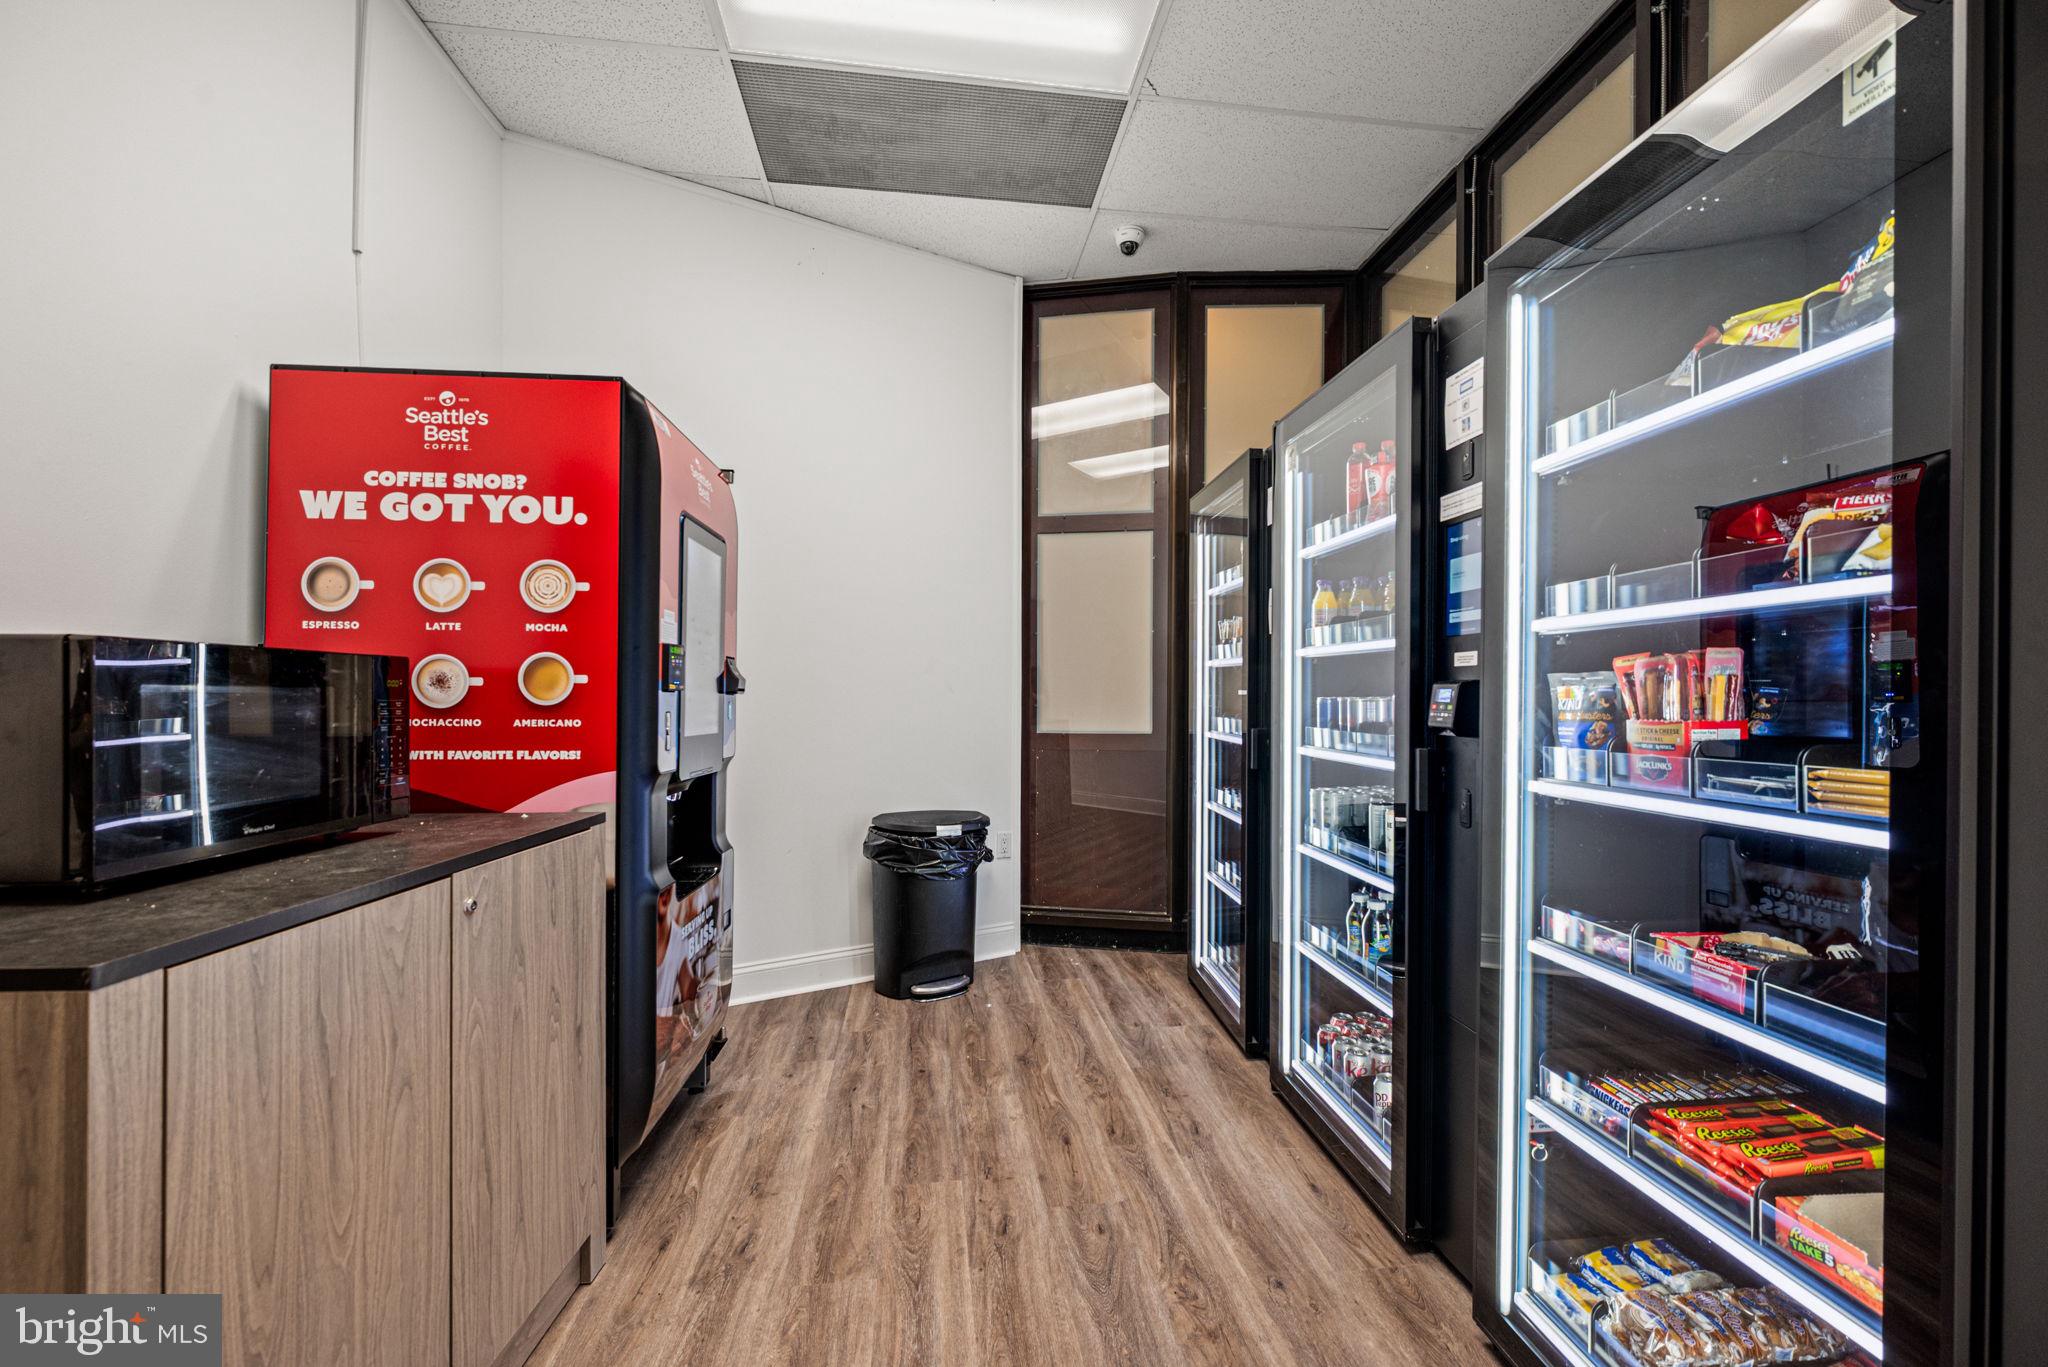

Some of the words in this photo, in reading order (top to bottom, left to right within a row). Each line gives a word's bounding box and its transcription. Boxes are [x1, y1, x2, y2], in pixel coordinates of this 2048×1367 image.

[405, 407, 488, 425] Seattle's
[424, 425, 469, 442] Best
[363, 470, 447, 487] COFFEE
[453, 474, 527, 490] SNOB?
[300, 490, 367, 520] WE
[380, 492, 473, 522] GOT
[480, 494, 588, 525] YOU.
[302, 620, 360, 630] ESPRESSO
[425, 622, 462, 631] LATTE
[525, 623, 568, 632] MOCHA
[409, 718, 482, 727] OCHACCINO
[513, 719, 582, 728] AMERICANO
[447, 750, 514, 760] FAVORITE
[516, 750, 581, 760] FLAVORS!
[1654, 950, 1685, 974] KIND
[1667, 1107, 1723, 1119] Reese's
[1696, 1126, 1756, 1140] Reese's
[1740, 1142, 1800, 1158] Reese's
[1790, 1226, 1830, 1253] Reese's
[1790, 1238, 1823, 1262] TAKE
[1824, 1252, 1837, 1268] 5
